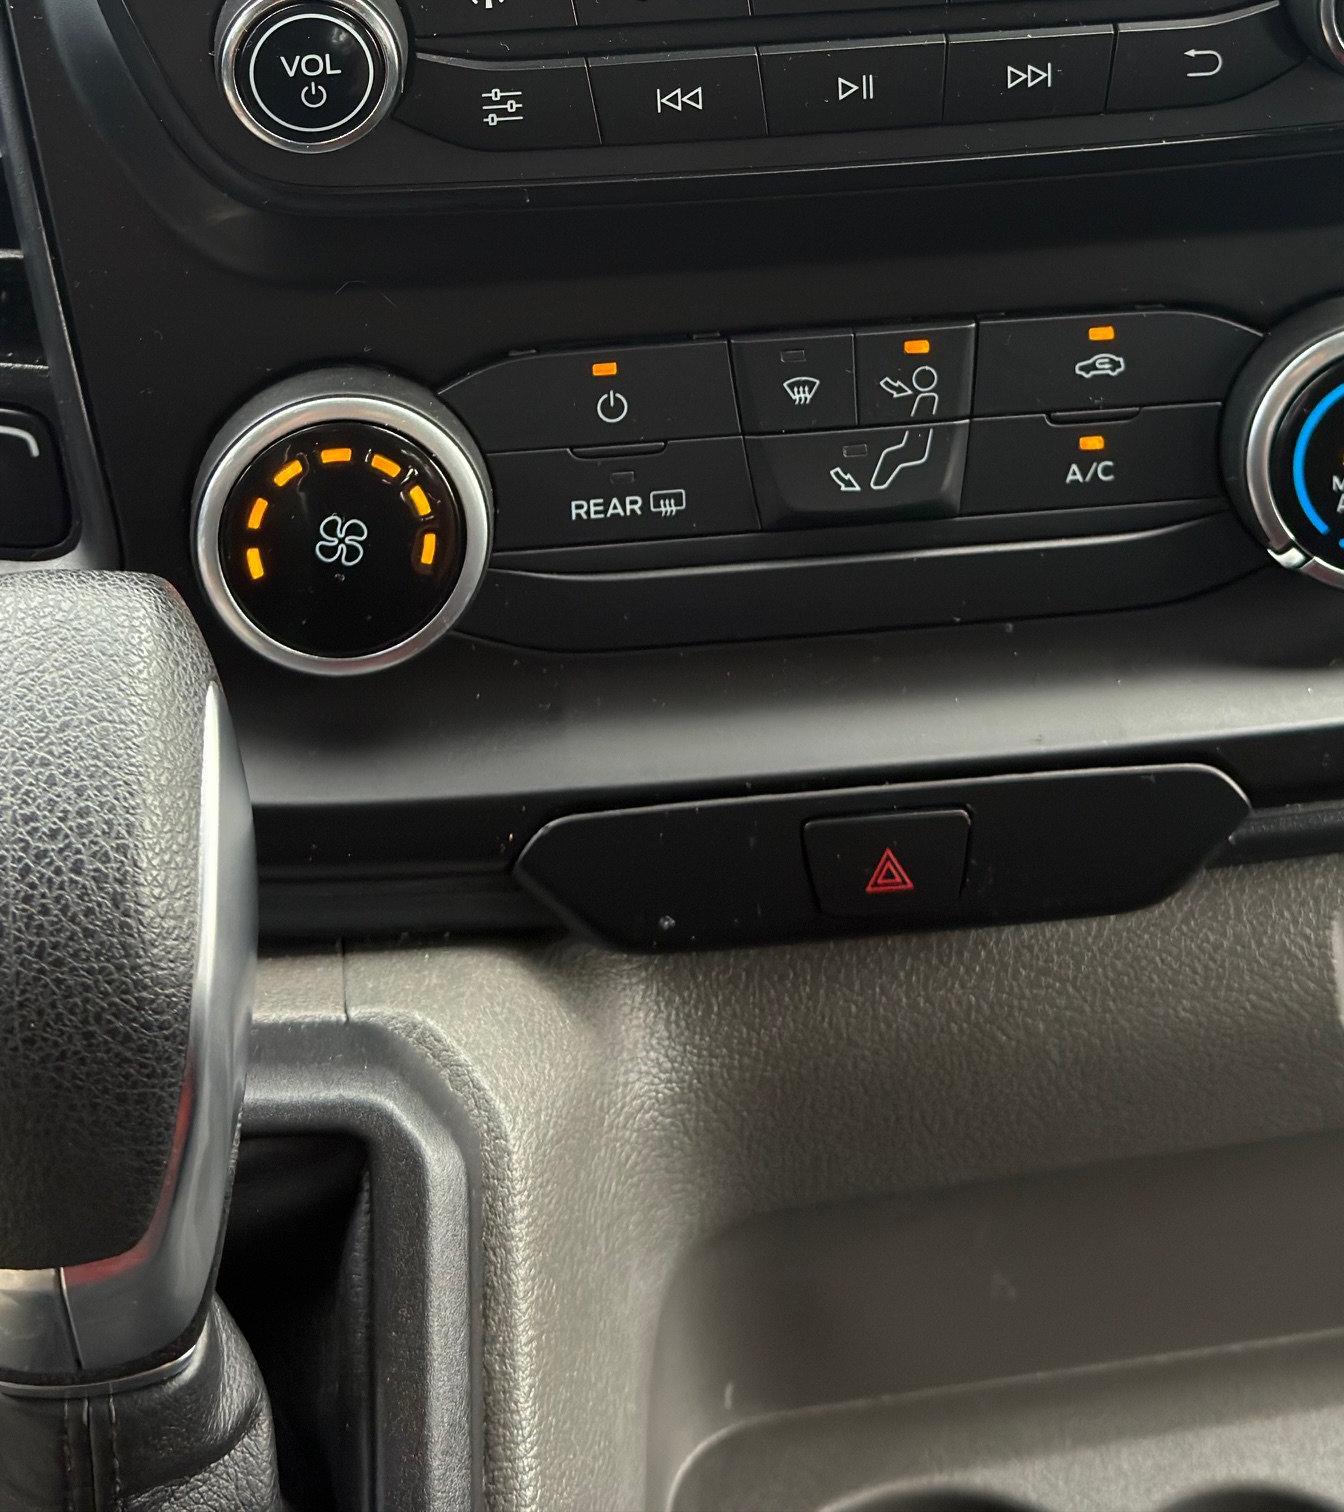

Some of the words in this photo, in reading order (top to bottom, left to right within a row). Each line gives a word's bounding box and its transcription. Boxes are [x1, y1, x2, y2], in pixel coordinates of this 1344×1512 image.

[279, 53, 342, 78] VOL
[1065, 460, 1114, 484] A/C
[569, 494, 644, 522] REAR
